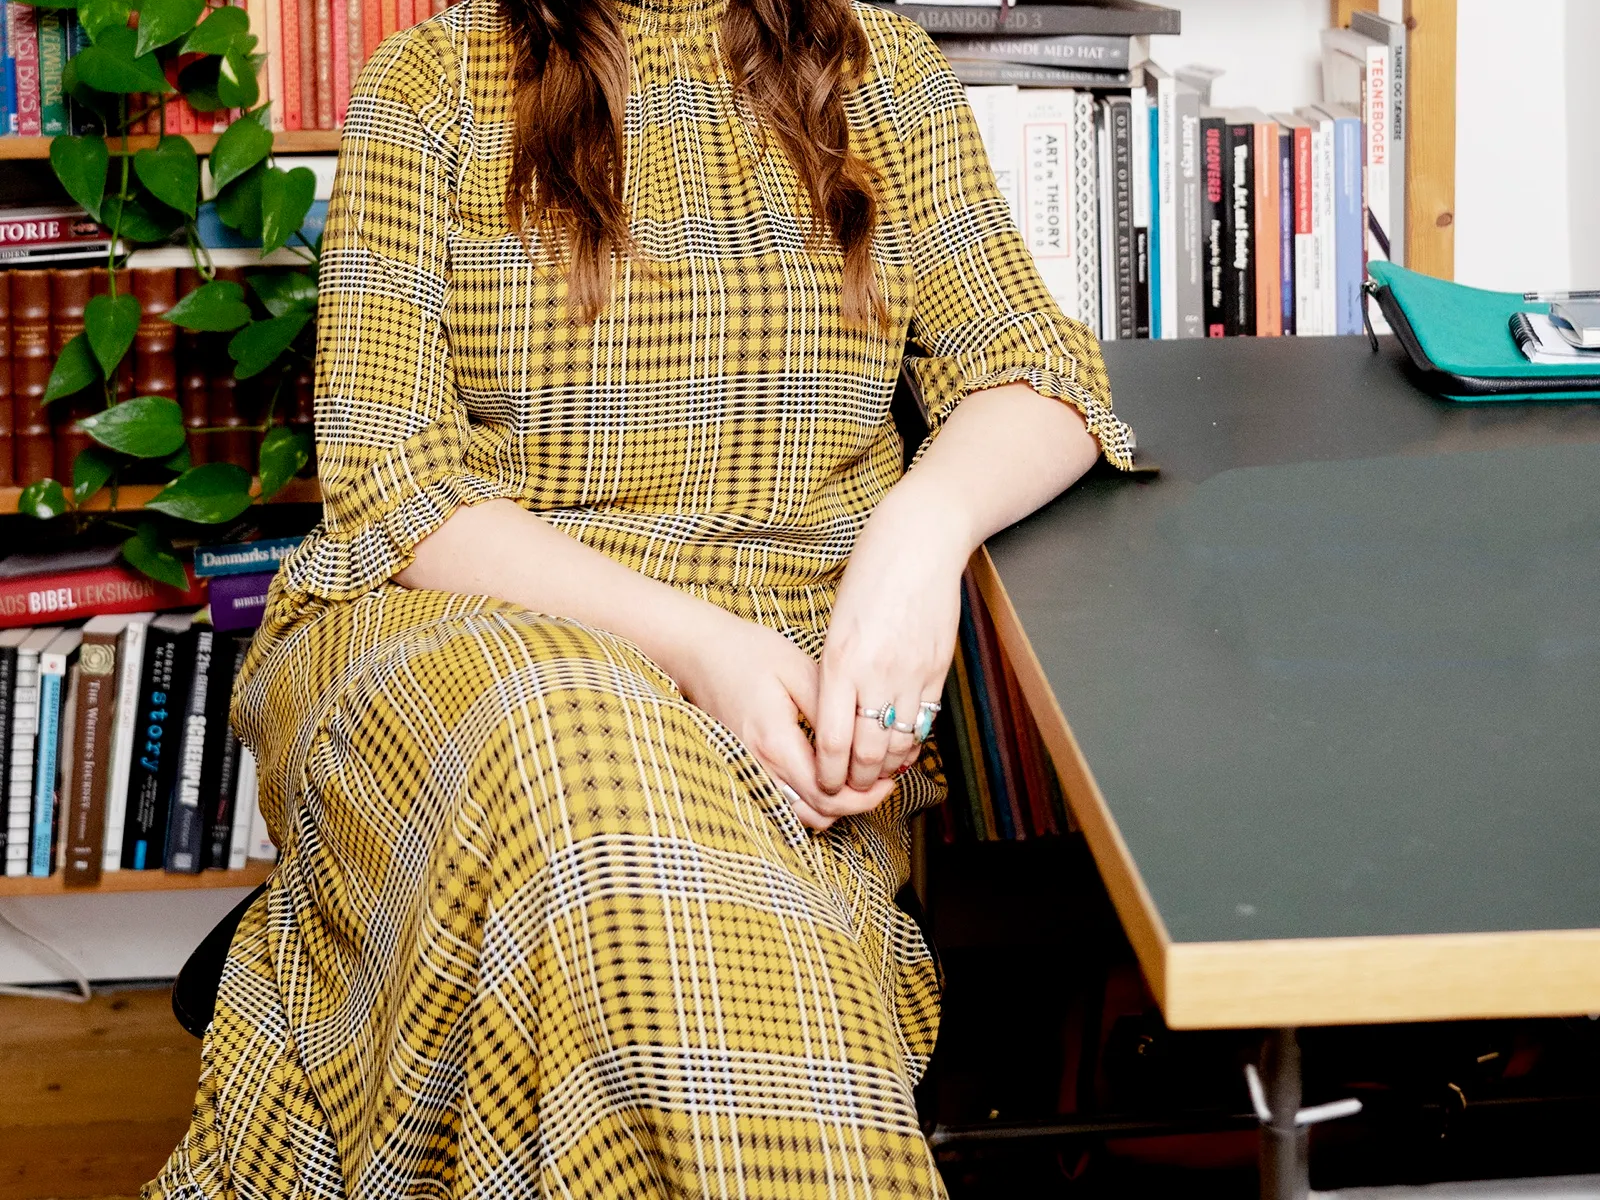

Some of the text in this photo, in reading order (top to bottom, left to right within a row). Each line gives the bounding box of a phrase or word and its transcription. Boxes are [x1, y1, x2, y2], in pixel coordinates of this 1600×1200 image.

[916, 9, 1043, 31] ABANDONED 3
[989, 41, 1047, 57] KVINDE
[1049, 43, 1075, 59] MED
[1077, 44, 1105, 60] HAT
[17, 65, 37, 113] BOYS
[1371, 57, 1386, 165] TEGNEBOGEN
[1393, 45, 1404, 141] TANKER OG TÆNKERE
[1046, 134, 1058, 165] ART
[1180, 114, 1198, 178] Journeys
[1206, 128, 1222, 203] UNCOVERED
[0, 221, 60, 241] TORIE
[1047, 184, 1060, 248] THEORY
[1115, 114, 1133, 338] OM AT OPLEVE ARKITEKTUR
[1234, 209, 1249, 230] and
[1233, 230, 1249, 270] Society
[202, 547, 270, 568] Danmarks
[161, 641, 176, 691] ROBERT
[196, 630, 214, 652] THE
[87, 680, 102, 704] THE
[83, 706, 99, 760] WRITER'S
[139, 691, 169, 773] story
[79, 760, 96, 810] JOURNEY
[179, 714, 207, 808] SCREENPLAY
